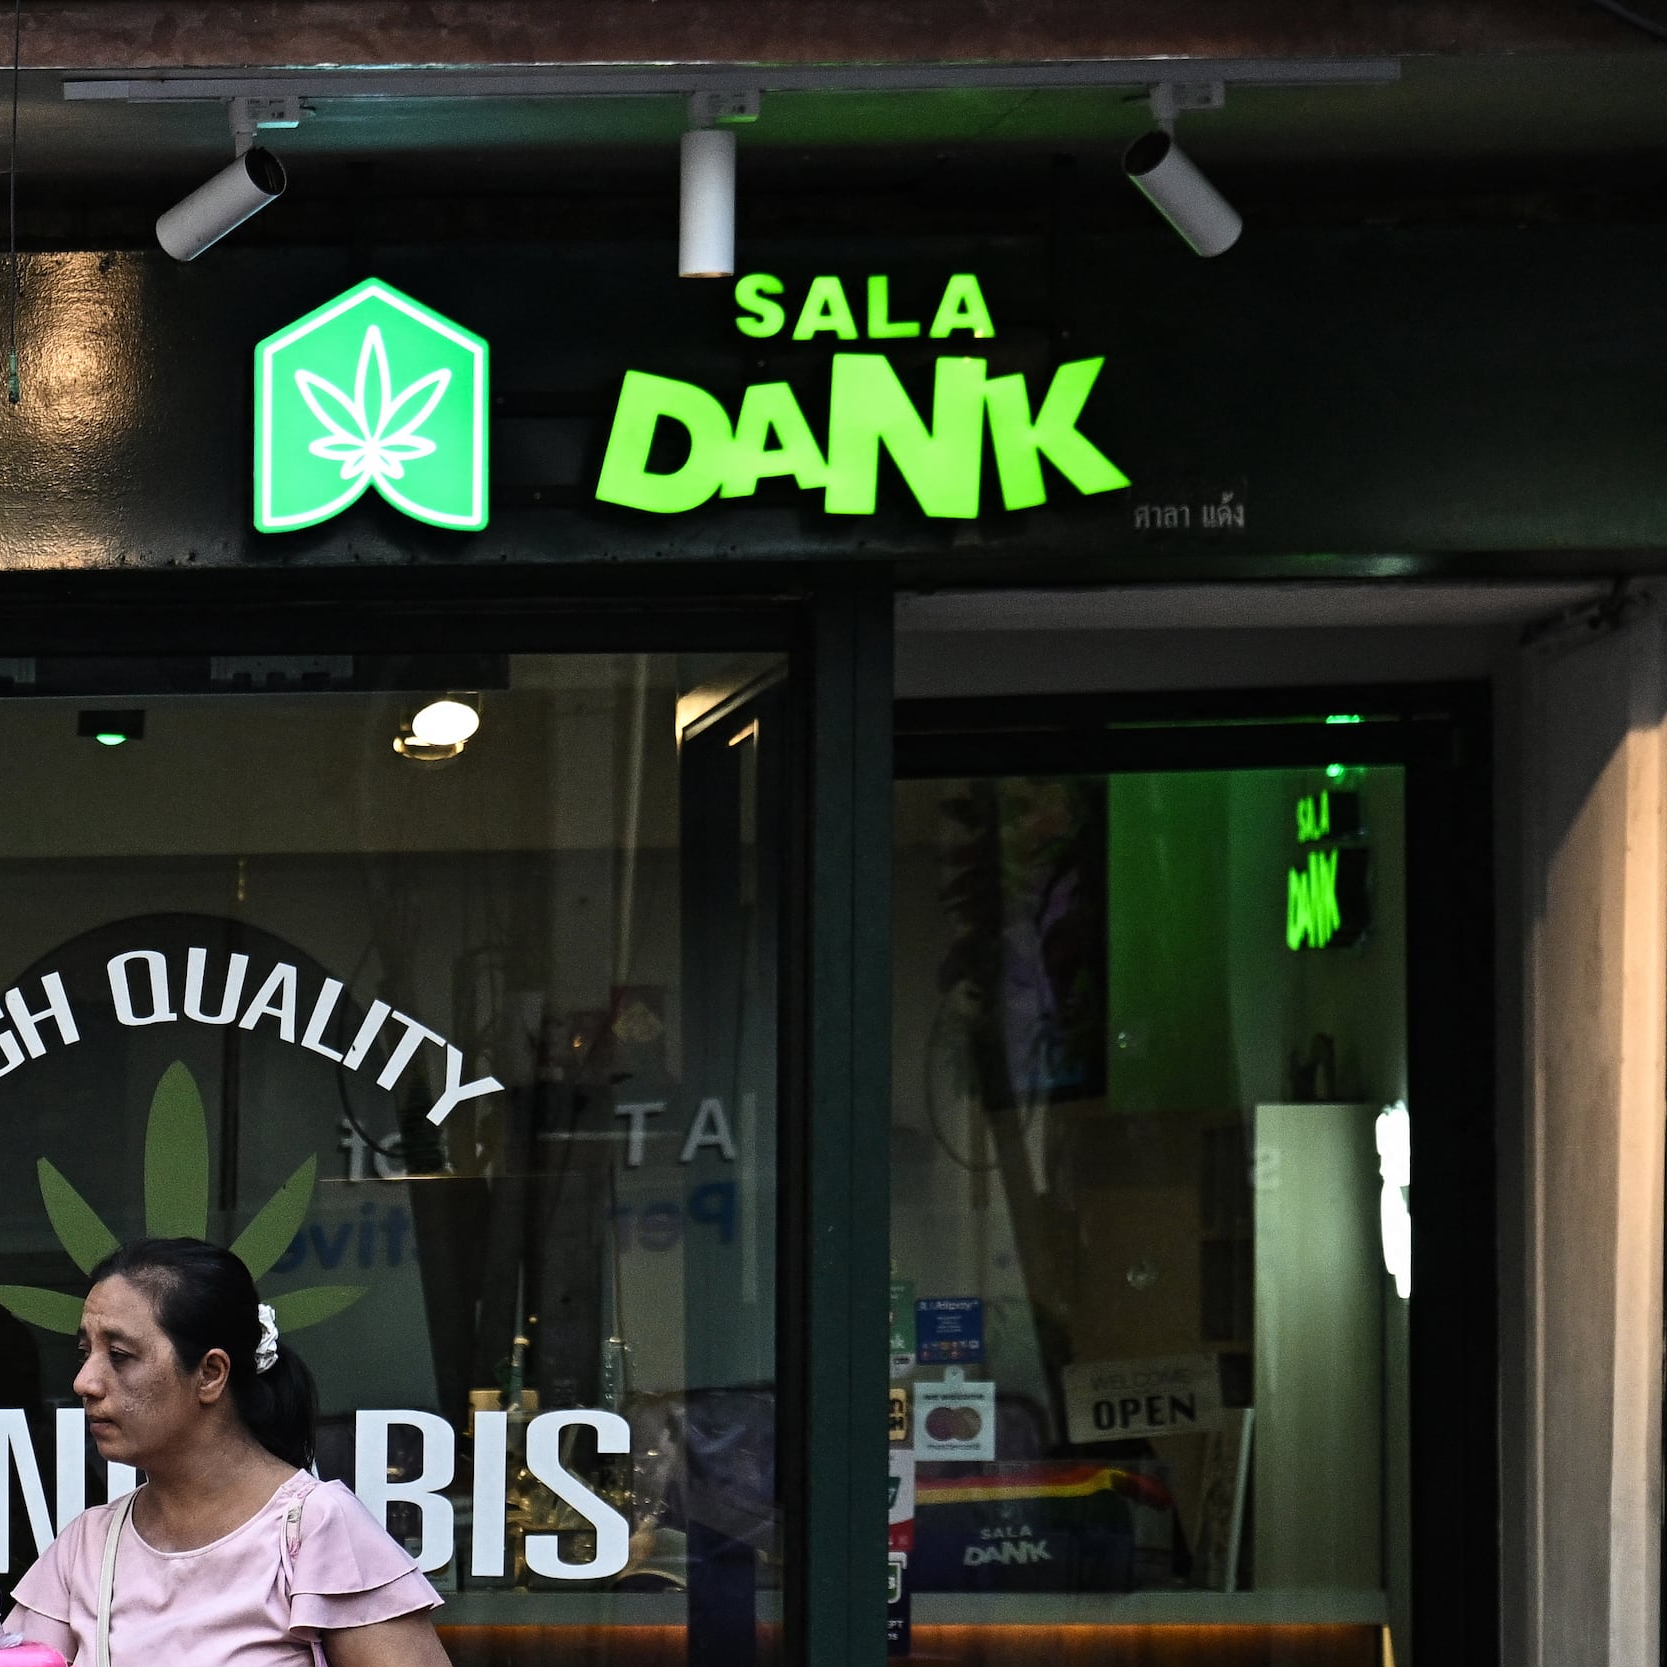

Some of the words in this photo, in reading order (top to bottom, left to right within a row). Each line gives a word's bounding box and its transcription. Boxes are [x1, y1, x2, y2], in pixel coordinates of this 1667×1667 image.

[734, 273, 994, 340] SALA
[595, 353, 1130, 519] DANK
[106, 947, 505, 1126] QUALITY
[1093, 1393, 1197, 1431] OPEN
[962, 1539, 1053, 1567] DANK
[980, 1524, 1034, 1541] SALA
